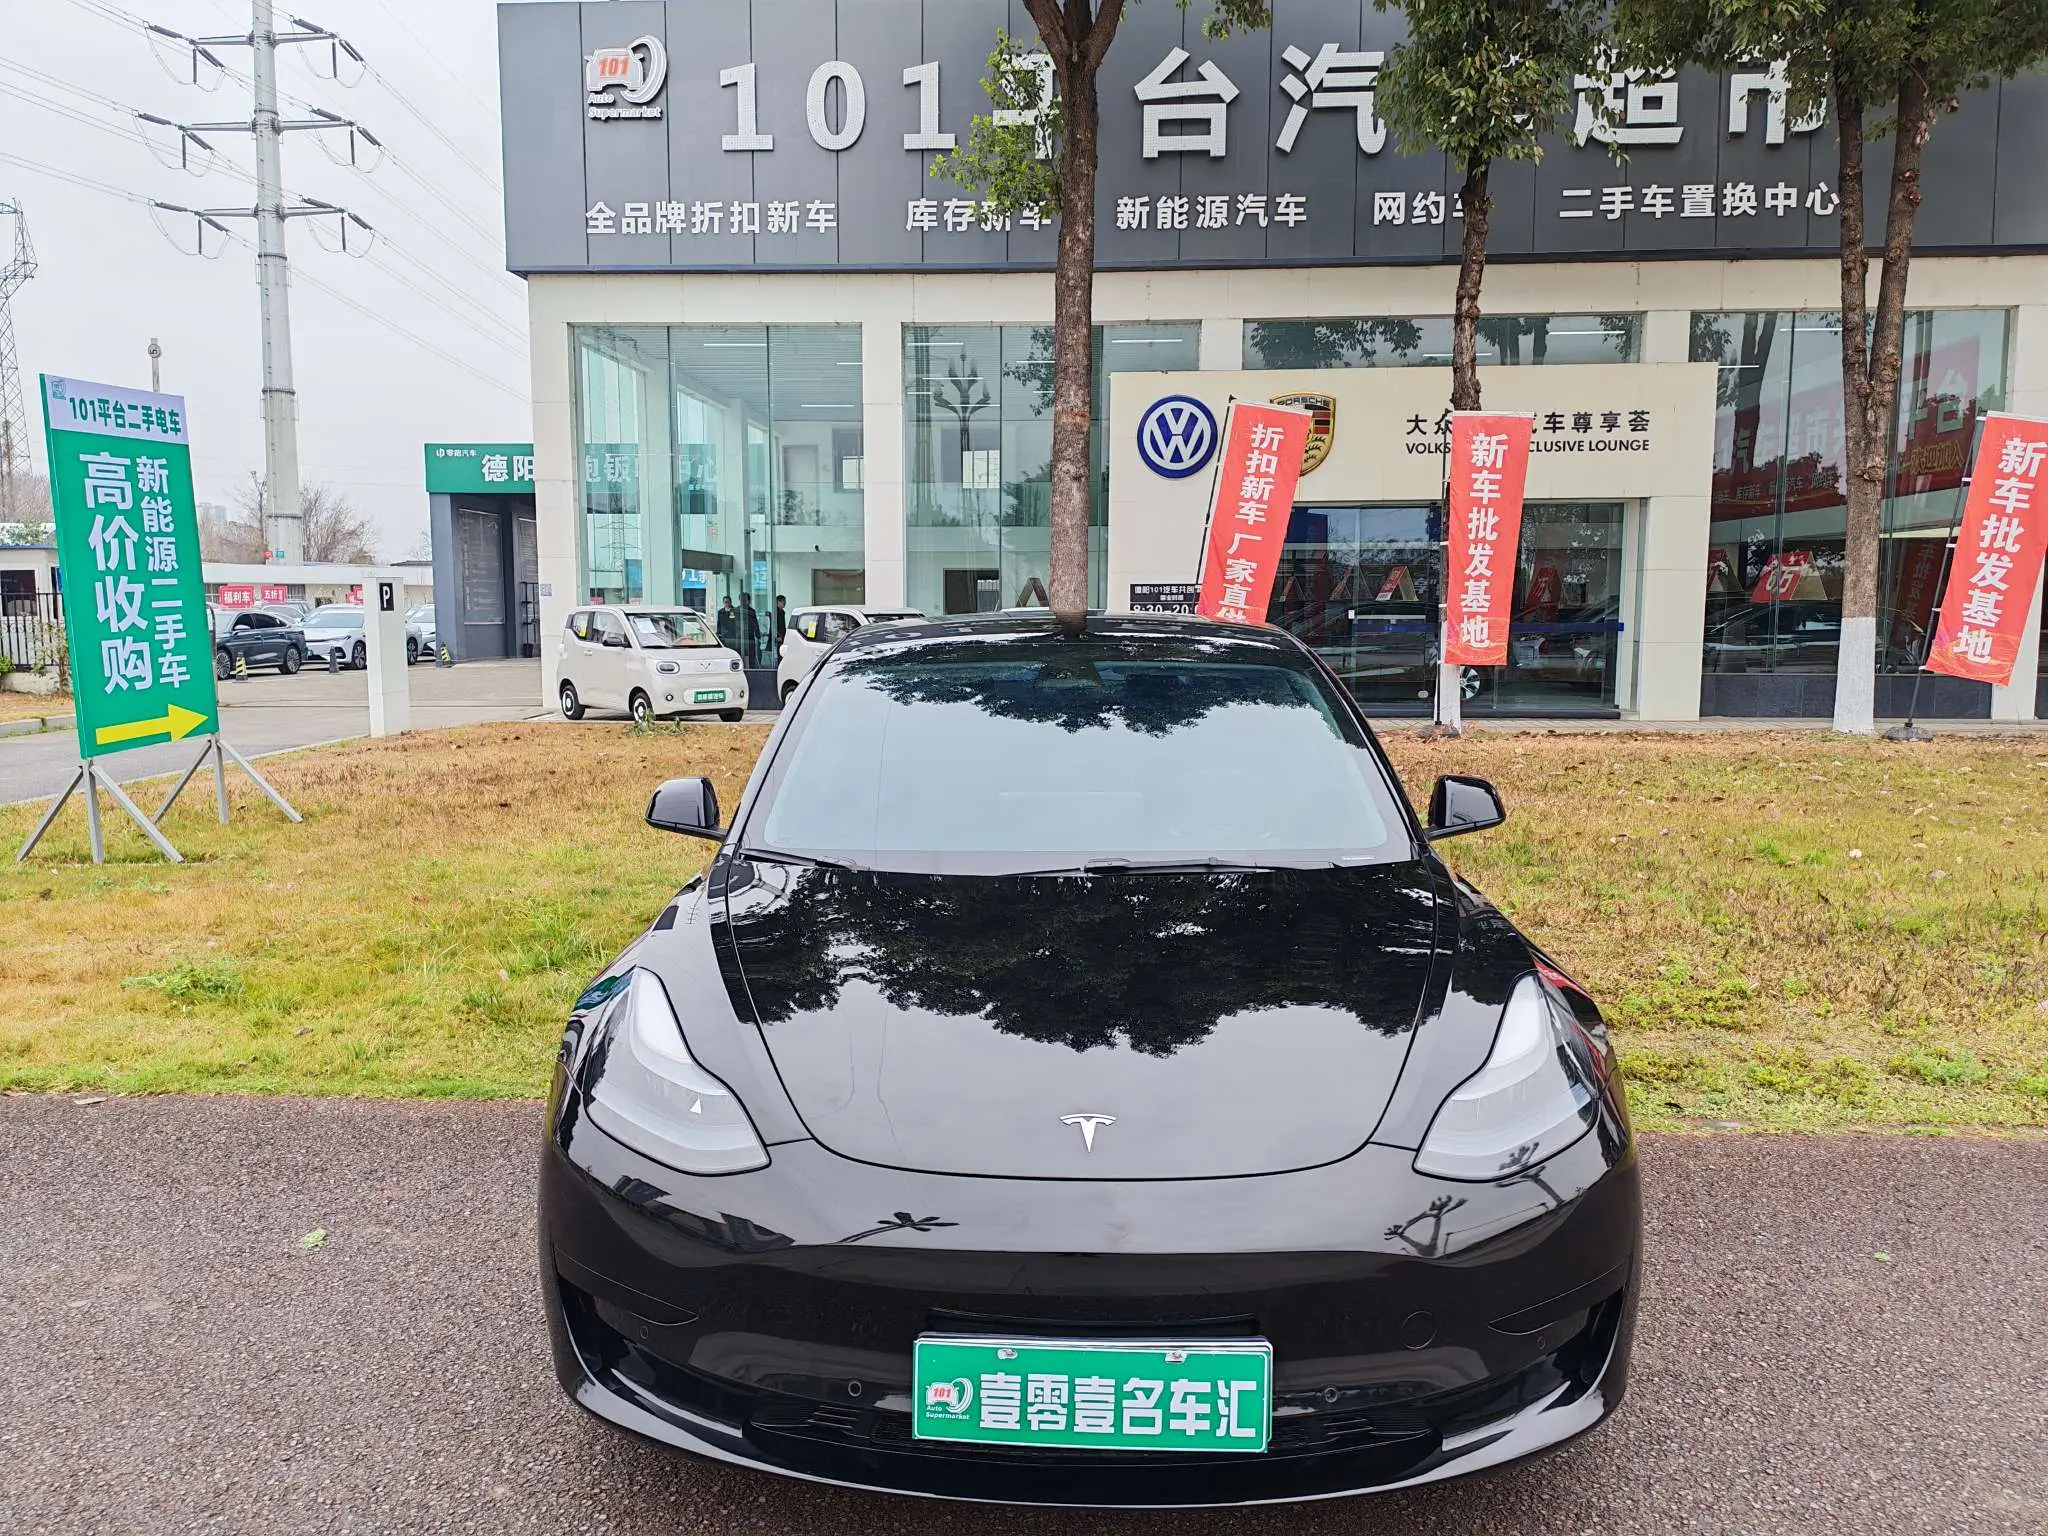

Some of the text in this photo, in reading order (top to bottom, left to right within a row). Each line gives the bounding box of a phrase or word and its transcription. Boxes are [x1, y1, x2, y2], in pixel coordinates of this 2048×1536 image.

[598, 56, 629, 78] 101
[587, 92, 615, 104] Auto
[588, 106, 662, 120] Supermarket
[586, 201, 837, 235] 全品牌折扣新车
[906, 198, 1052, 232] 库存新车
[1117, 194, 1307, 230] 新能源汽车
[1559, 182, 1840, 219] 二手车置换中心
[69, 397, 181, 435] 101平台二手电车
[1406, 441, 1451, 454] VOLKS
[1588, 438, 1650, 452] LOUNGE
[1460, 433, 1508, 648] 新车批发基地
[1953, 437, 2047, 664] 新车批发基地
[80, 452, 153, 695] 高价收购
[136, 456, 191, 688] 新能源二手车
[383, 586, 391, 608] P
[934, 1387, 951, 1398] 101
[980, 1372, 1257, 1438] 壹零壹名车汇
[926, 1411, 970, 1420] Supermarket
